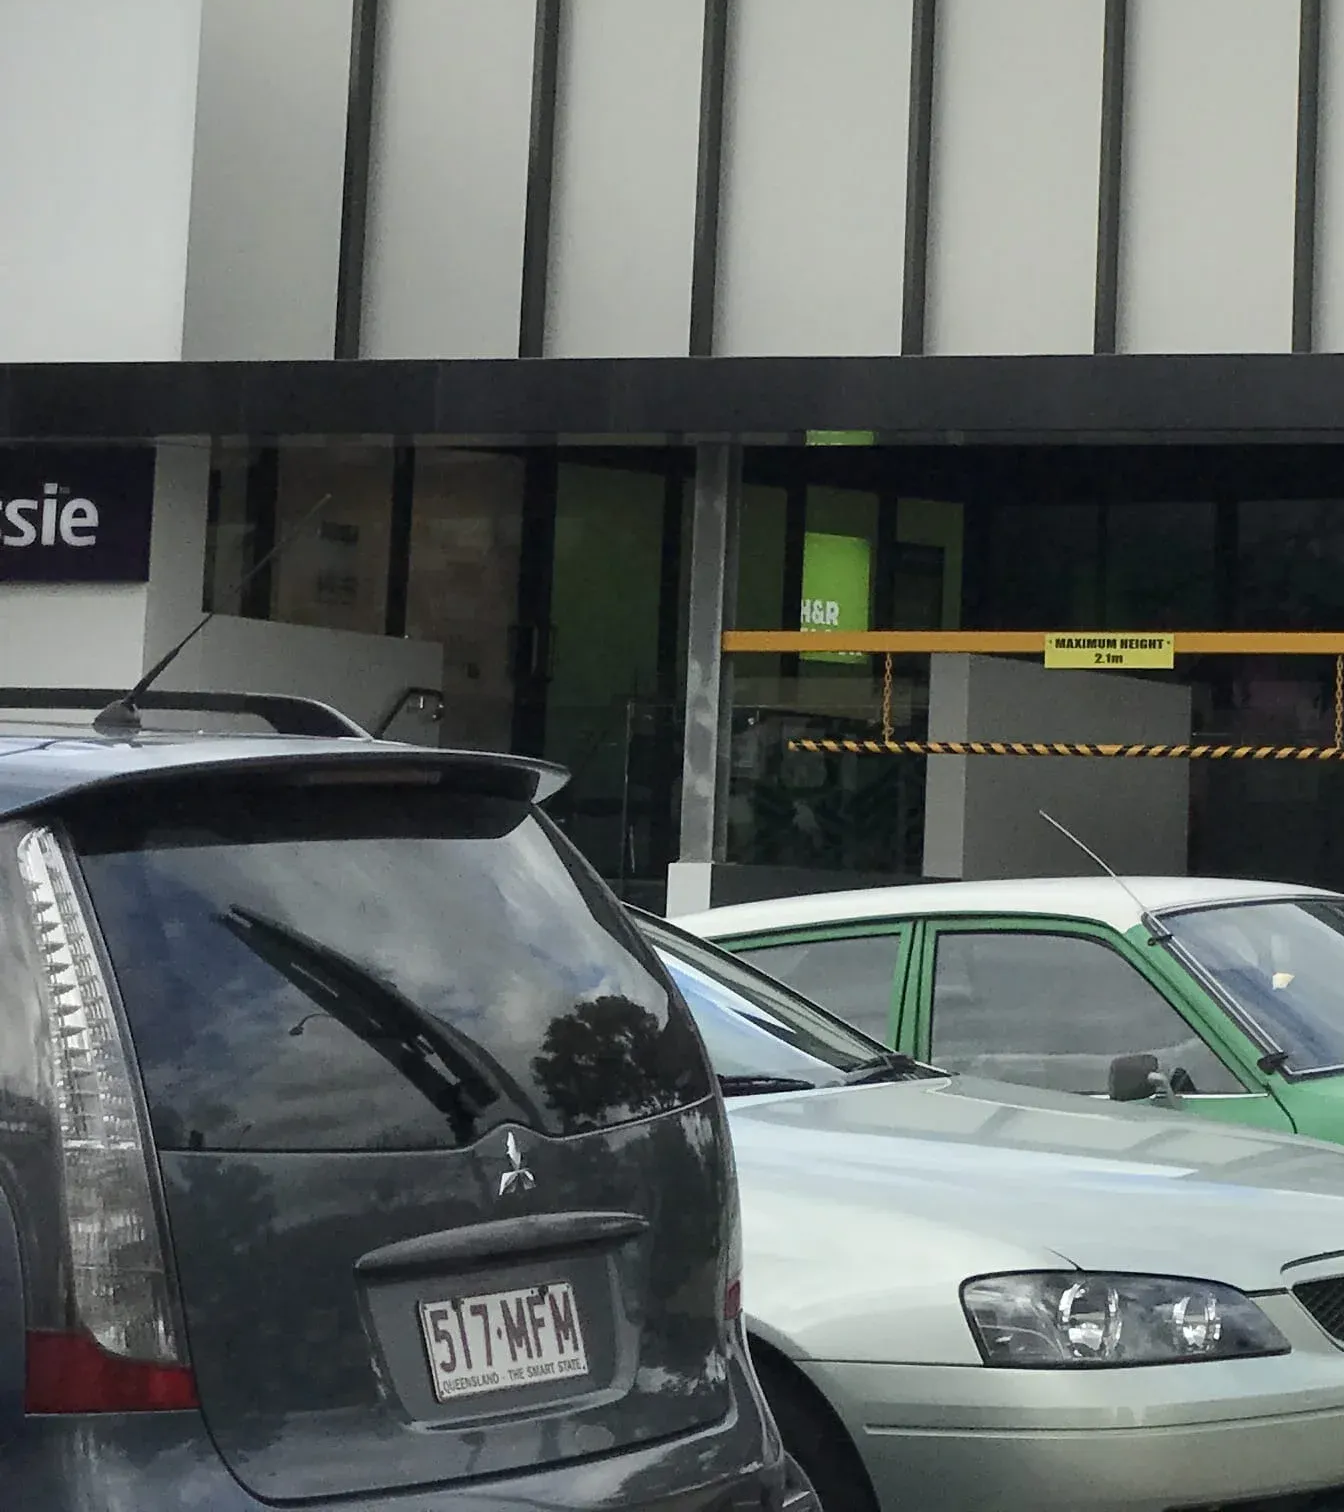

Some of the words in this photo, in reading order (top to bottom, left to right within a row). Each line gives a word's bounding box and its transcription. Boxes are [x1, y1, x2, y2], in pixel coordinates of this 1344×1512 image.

[1055, 637, 1117, 649] MAXIMUM
[1120, 638, 1164, 650] HEIGHT
[1094, 653, 1123, 664] 2.1m
[442, 1371, 500, 1394] QUEENSLAND
[507, 1368, 525, 1381] THE
[526, 1362, 556, 1377] SMART
[557, 1358, 581, 1373] STATE
